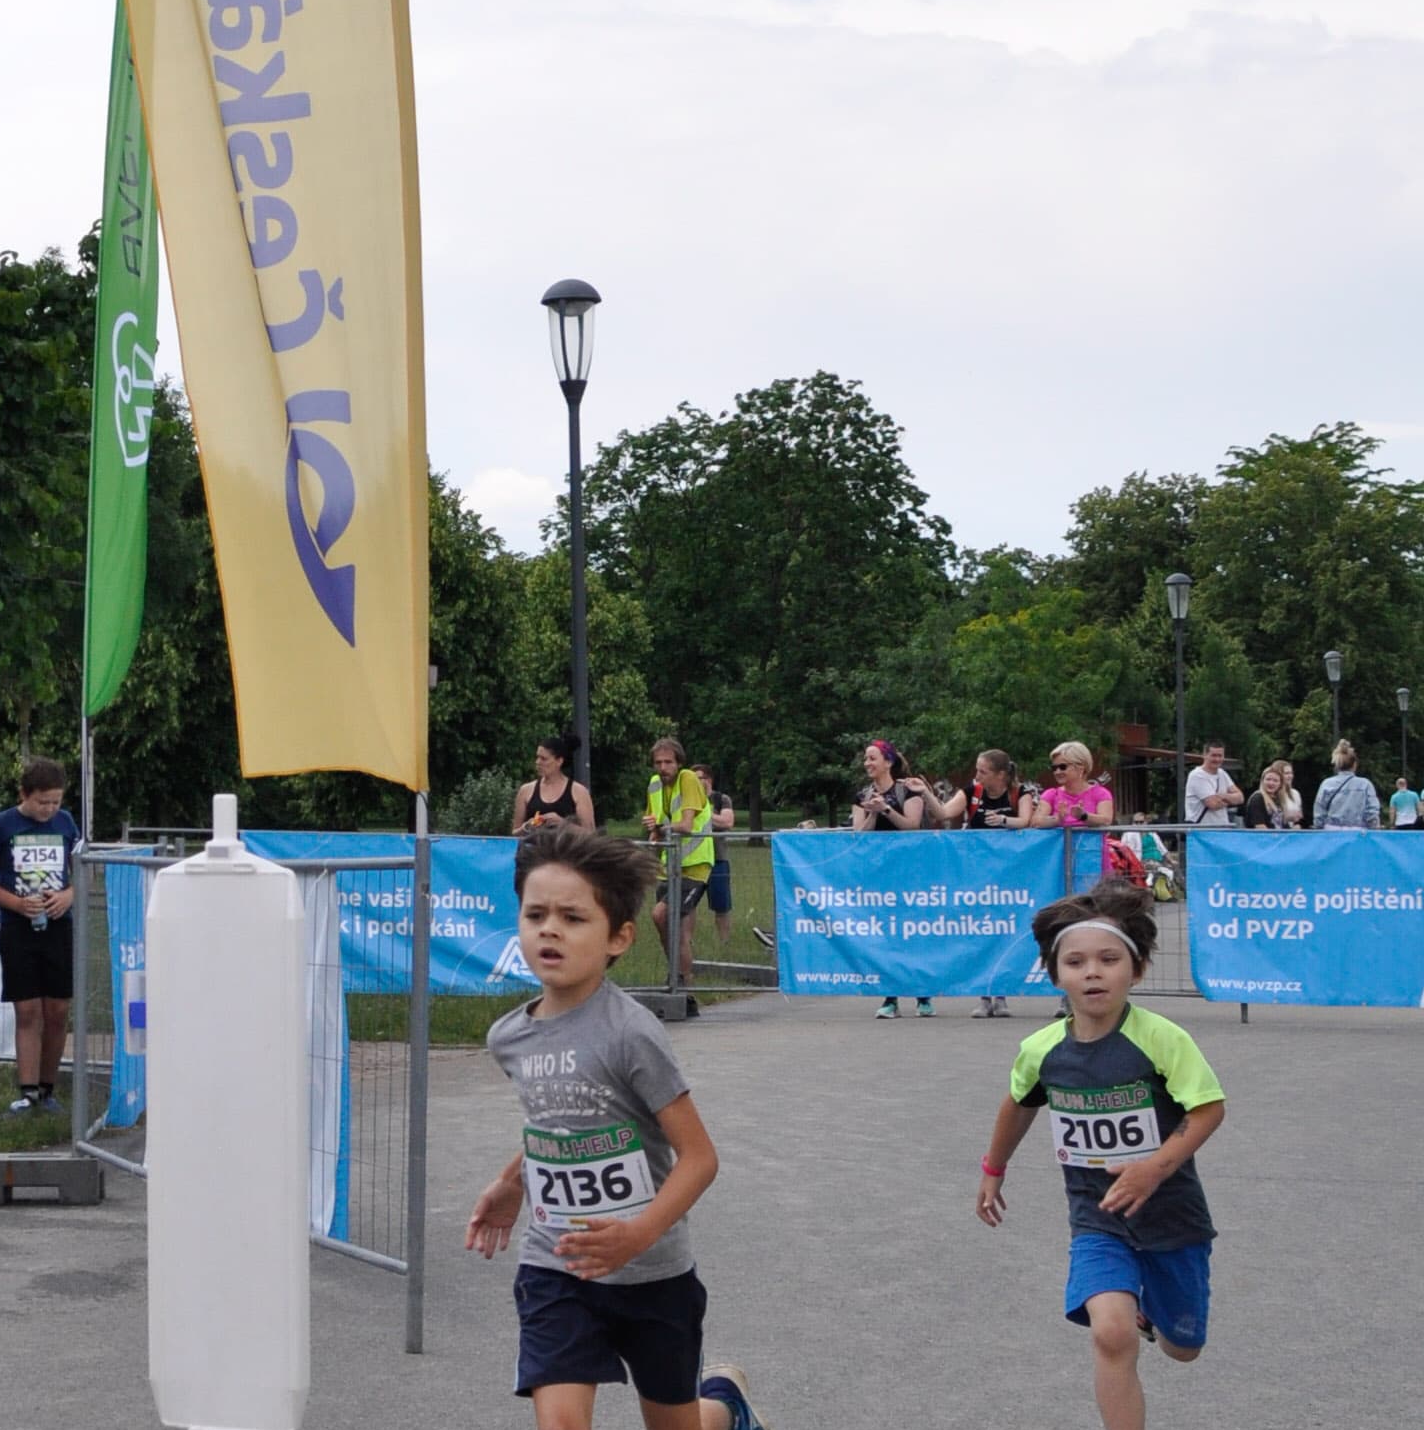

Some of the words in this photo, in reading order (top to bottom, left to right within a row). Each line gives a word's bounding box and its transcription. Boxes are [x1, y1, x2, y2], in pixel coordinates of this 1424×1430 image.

[22, 847, 58, 863] 2154
[366, 888, 412, 909] vaši
[426, 888, 496, 914] odinu,
[793, 886, 897, 910] Pojistíme
[902, 885, 947, 907] vaši
[953, 885, 1035, 908] rodinu,
[1208, 882, 1307, 909] Úrazové
[1314, 887, 1423, 914] pojištění
[367, 916, 476, 939] podkání
[795, 915, 885, 939] majetek
[889, 915, 897, 935] i
[903, 914, 1017, 940] podnikání
[1207, 918, 1239, 939] od
[1246, 920, 1315, 940] PVZP
[795, 972, 881, 986] www.pvzp.cz
[1207, 977, 1303, 992] www.pvzp.cz
[521, 1053, 556, 1078] WHO
[560, 1049, 577, 1075] IS
[1097, 1087, 1148, 1109] HELP
[572, 1128, 634, 1159] HELP
[1059, 1115, 1145, 1150] 2106
[536, 1162, 633, 1207] 2136
